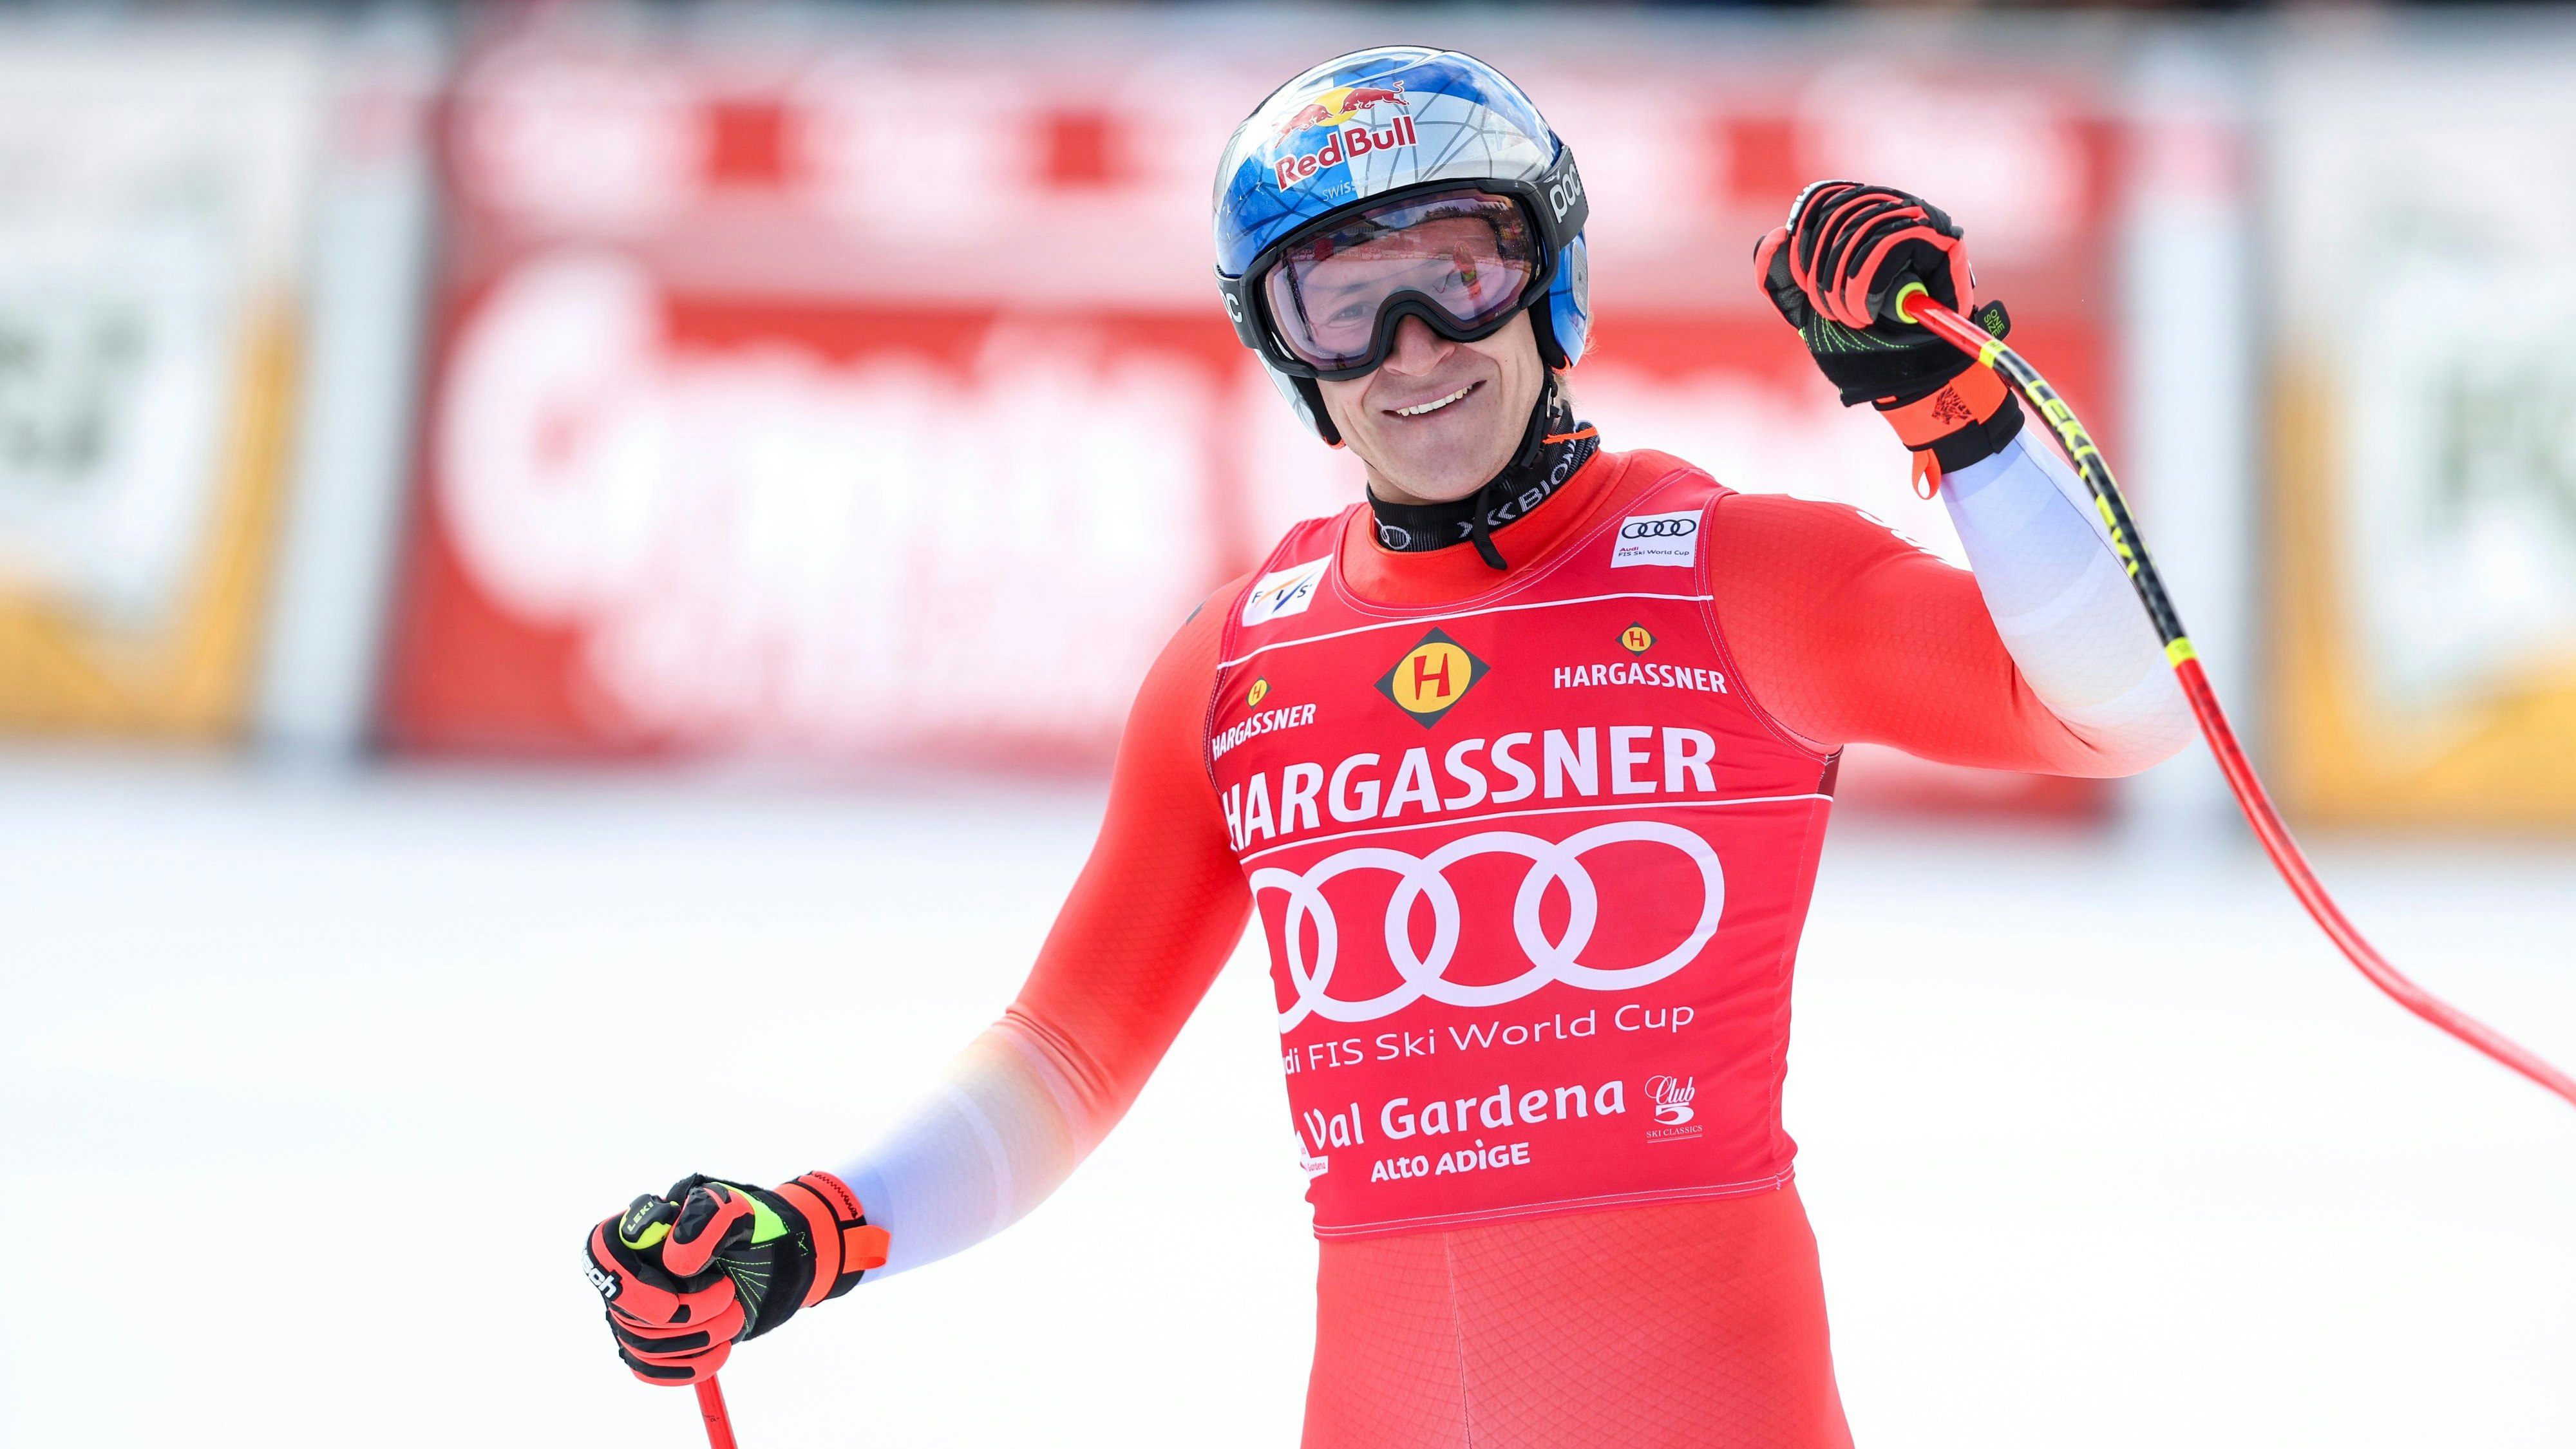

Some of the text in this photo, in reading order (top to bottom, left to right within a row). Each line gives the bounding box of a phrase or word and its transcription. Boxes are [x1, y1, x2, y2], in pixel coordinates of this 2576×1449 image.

[1274, 115, 1417, 191] Red Bull
[1984, 314, 1998, 337] SIZE
[1990, 309, 2005, 334] ONE
[1628, 630, 1645, 647] H
[1414, 653, 1451, 701] H
[1553, 662, 1728, 695] HARGASSNER
[1211, 703, 1316, 761] HARGASSNER
[1222, 725, 1718, 851] HARGASSNER
[1308, 1037, 1364, 1070] FIS
[1375, 1028, 1435, 1061] Ski
[1448, 1003, 1596, 1050] World
[1614, 1003, 1695, 1033] Cup
[1644, 1075, 1696, 1104] Club
[1303, 1079, 1626, 1151] Val Gardena
[1653, 1101, 1694, 1126] 5
[1646, 1124, 1703, 1138] SKI CLASSICS
[627, 1200, 654, 1232] LEKI
